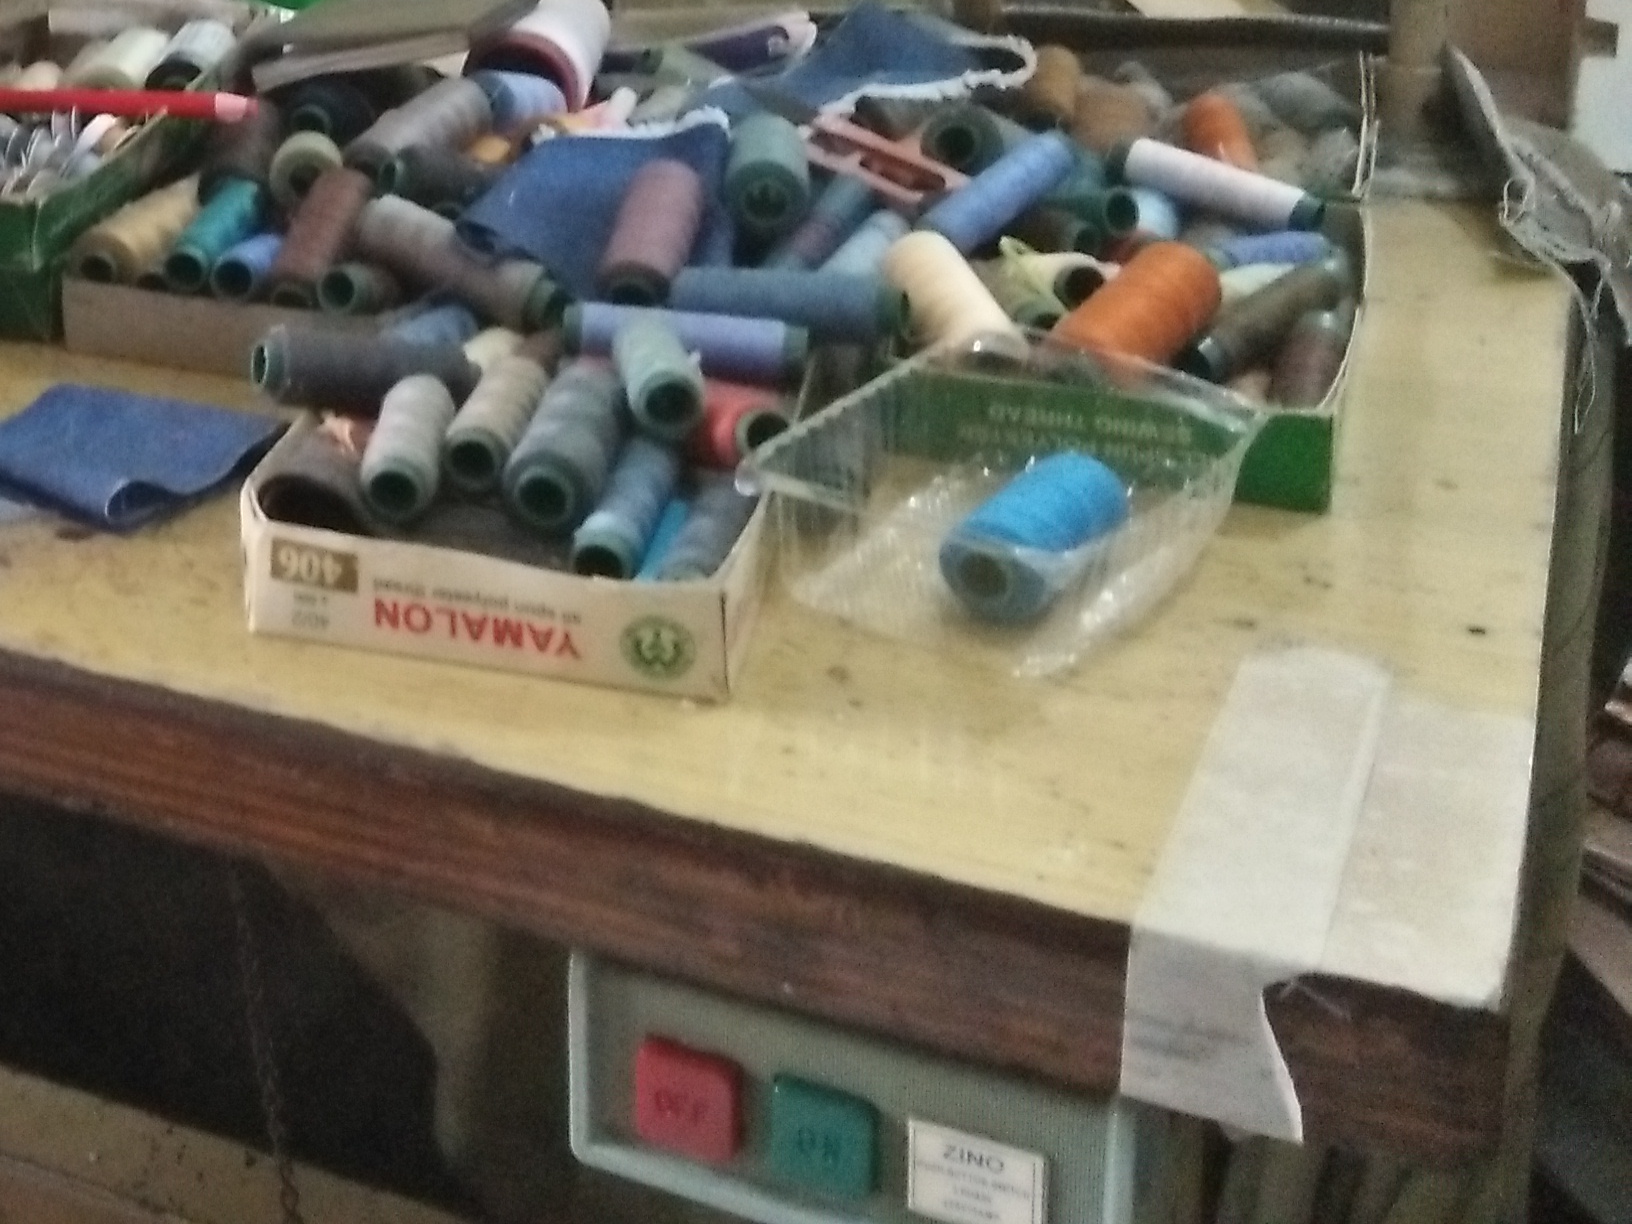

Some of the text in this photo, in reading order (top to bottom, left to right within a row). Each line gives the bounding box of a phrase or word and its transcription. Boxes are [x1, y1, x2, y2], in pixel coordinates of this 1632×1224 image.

[277, 544, 344, 586] 406
[373, 599, 582, 660] YAMALON
[942, 1143, 1006, 1175] ZINO
